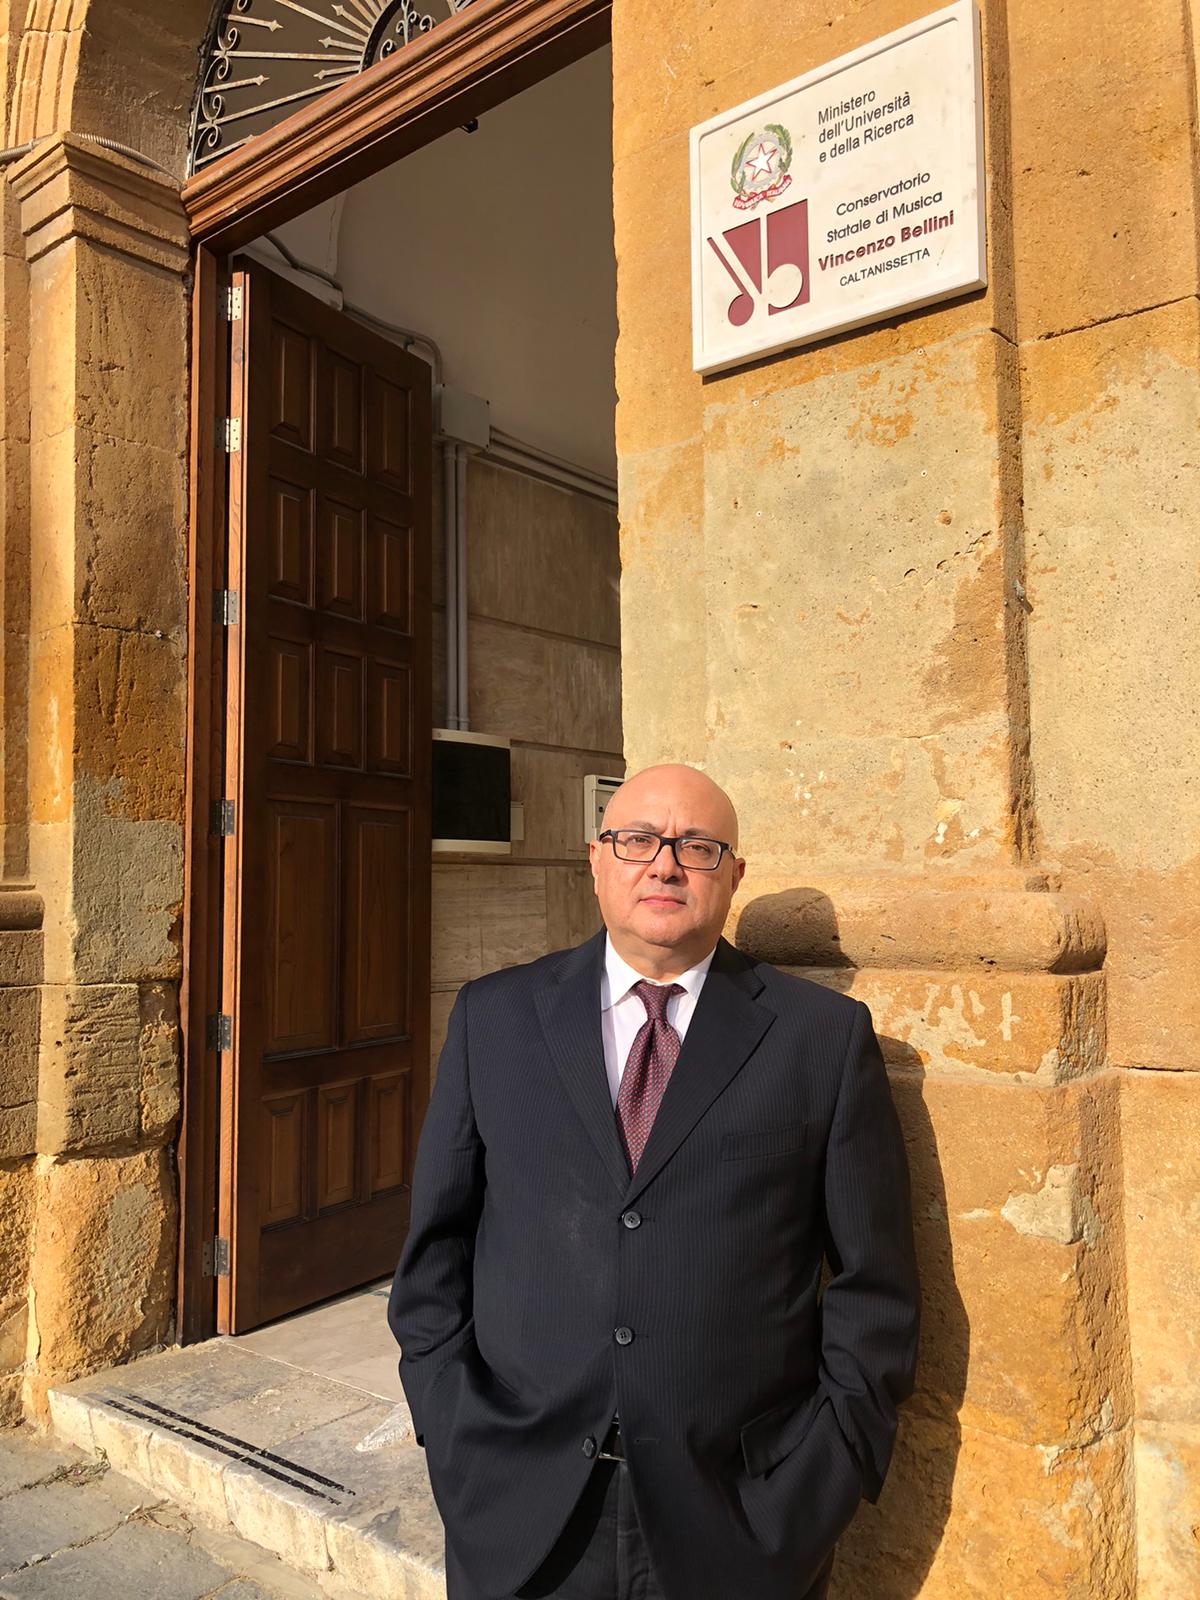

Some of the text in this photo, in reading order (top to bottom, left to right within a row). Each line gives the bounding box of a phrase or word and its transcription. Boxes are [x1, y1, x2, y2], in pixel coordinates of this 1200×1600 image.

[818, 90, 876, 125] Ministero
[818, 91, 911, 143] dell'Università
[819, 113, 914, 163] e della Ricerca
[826, 191, 943, 243] Statale di Musica
[836, 172, 931, 216] Conservatorio
[818, 209, 954, 272] Vincenzo Bellini
[839, 247, 931, 287] CALTANISSETTA
